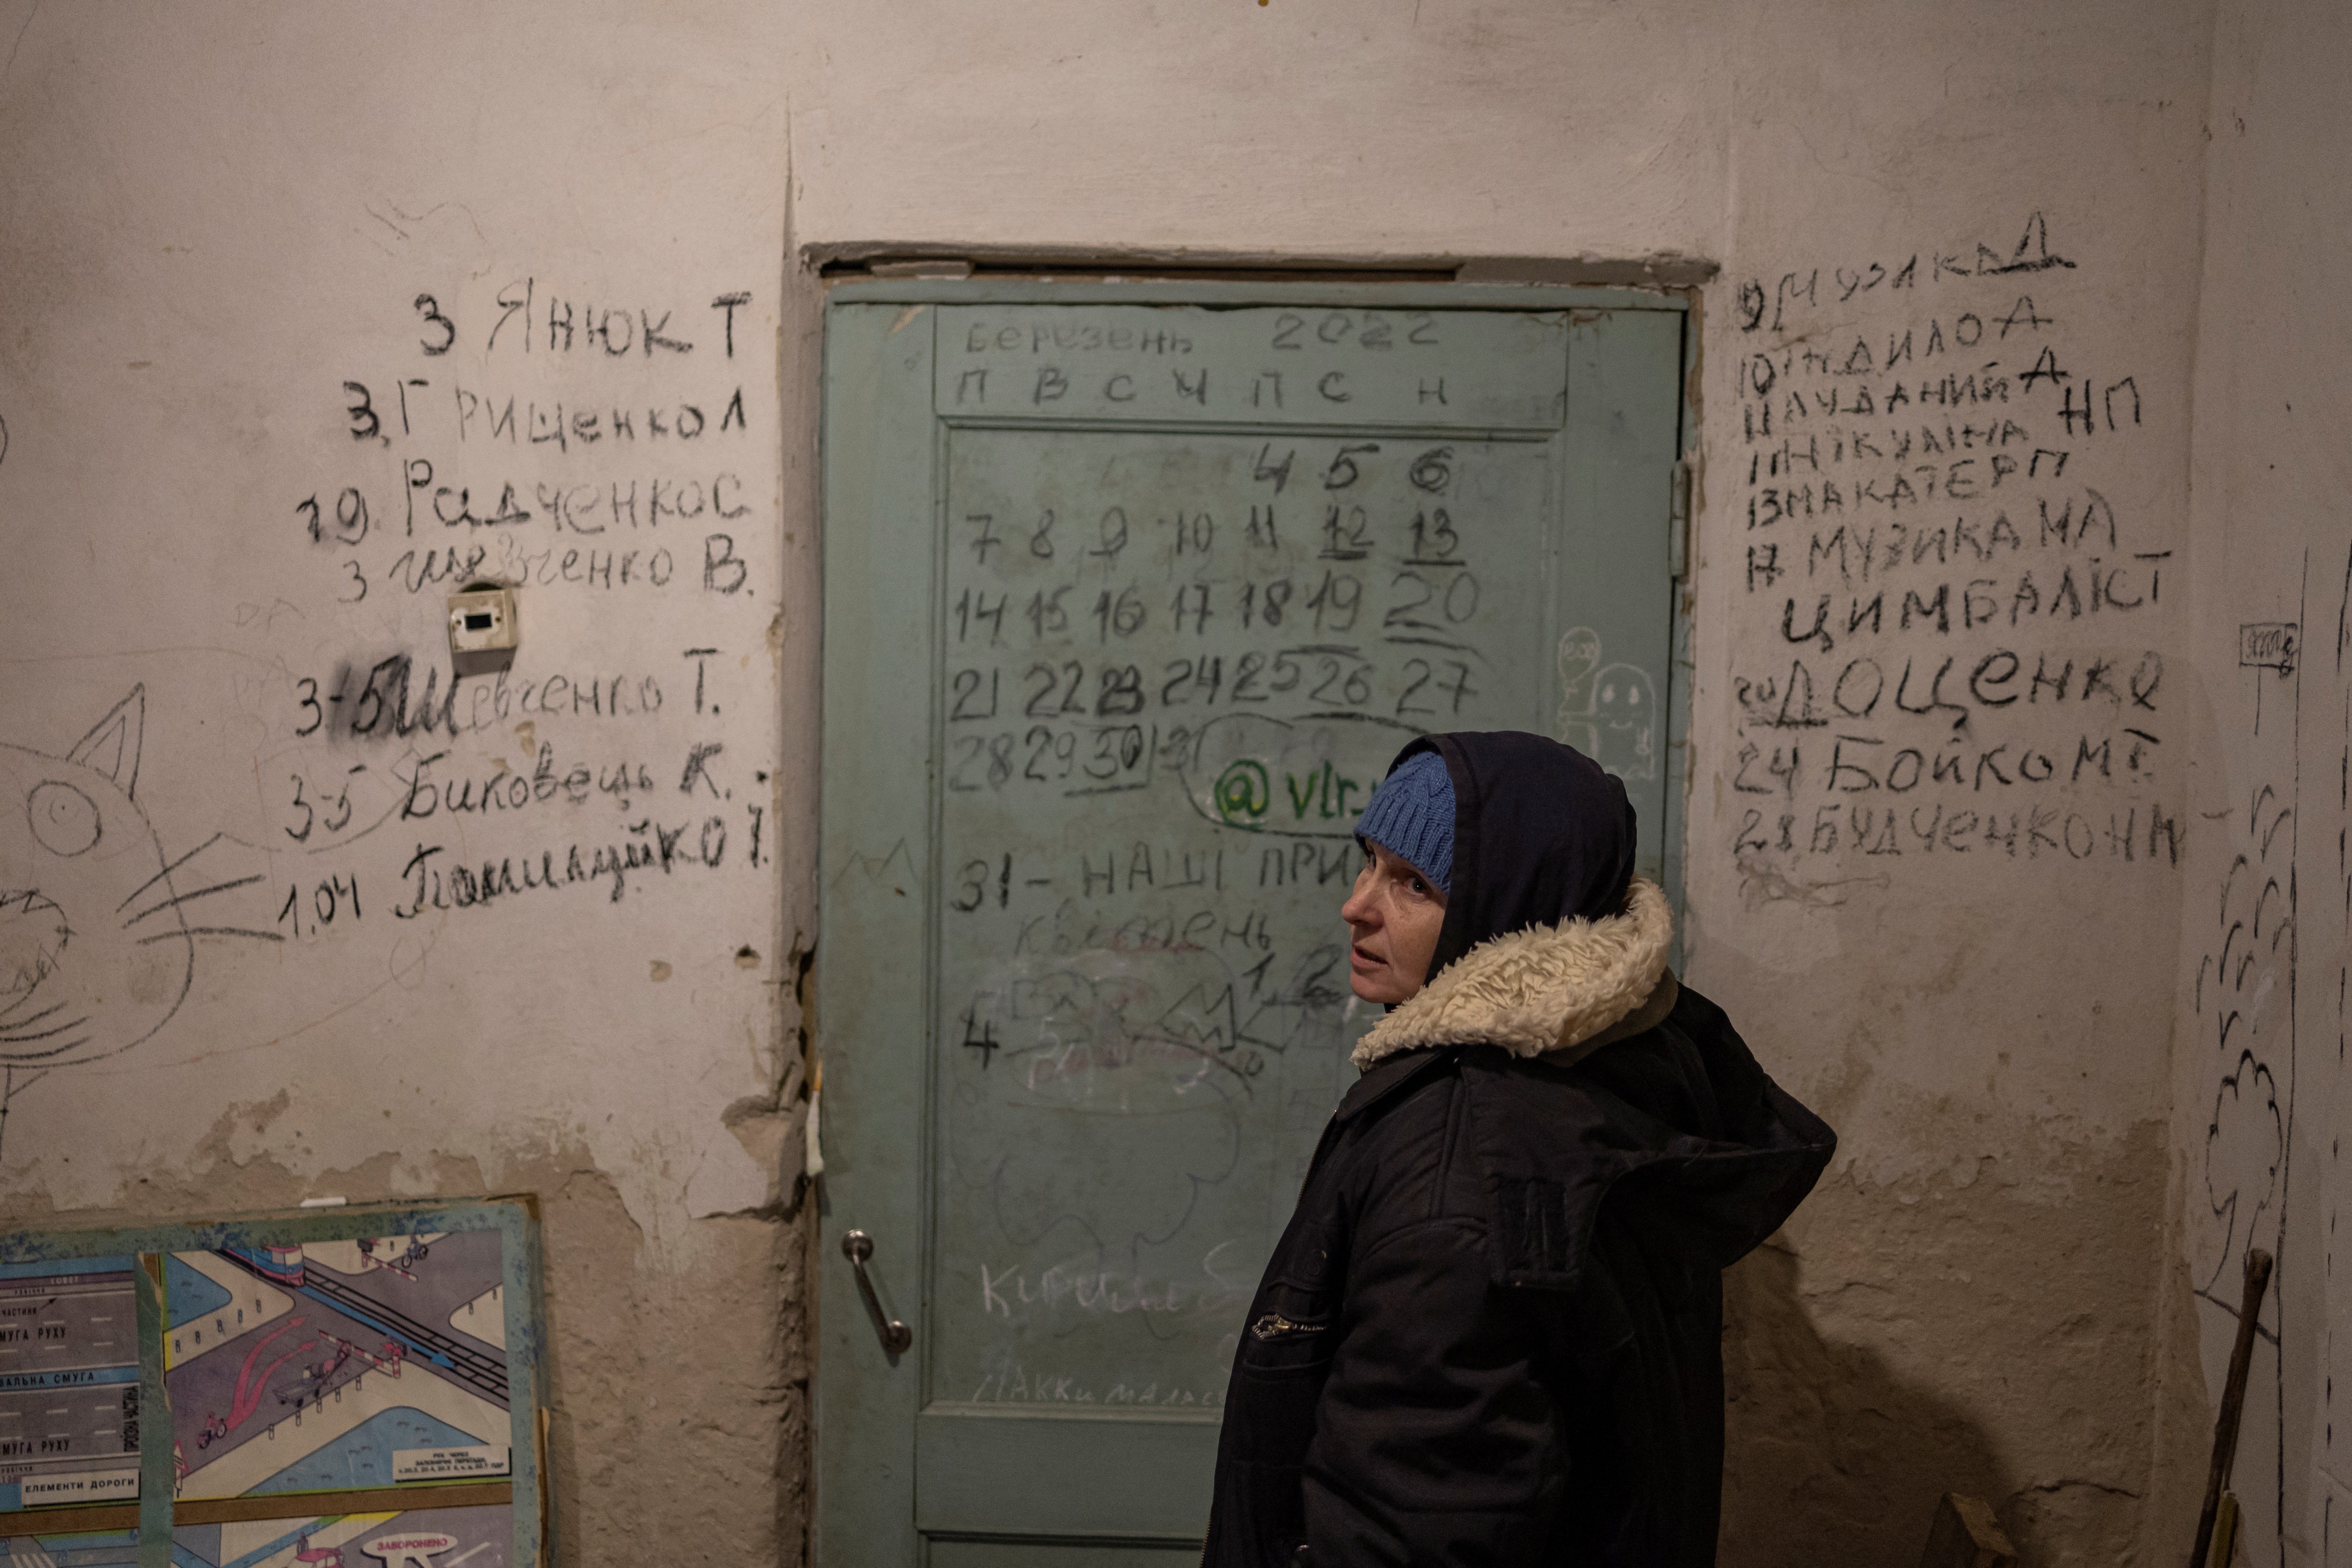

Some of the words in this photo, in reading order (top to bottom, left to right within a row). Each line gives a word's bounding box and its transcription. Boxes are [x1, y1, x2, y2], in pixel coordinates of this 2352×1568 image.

[414, 292, 456, 357] 3
[486, 276, 694, 358] ЯНЮК
[710, 291, 753, 358] Т
[1272, 313, 1439, 353] 2022
[955, 368, 989, 405] П
[1034, 366, 1069, 406] В
[1419, 375, 1447, 406] Н
[1254, 442, 1296, 496] 4
[1323, 443, 1380, 490] 5
[1410, 445, 1453, 494] 6
[965, 513, 1002, 565] 7
[1029, 508, 1056, 559] 8
[1088, 505, 1128, 557] 9
[1174, 510, 1214, 556] 10
[1244, 504, 1279, 550] 11
[1322, 504, 1374, 552] 12
[1411, 508, 1458, 559] 13
[954, 587, 1007, 643] 14
[1024, 584, 1075, 635] 15
[1092, 582, 1147, 641] 16
[1171, 583, 1214, 642] 17
[1240, 579, 1293, 629] 18
[1306, 570, 1363, 639] 19
[1383, 571, 1480, 630] 20
[949, 667, 999, 722] 21
[1024, 660, 1087, 718] 22
[1095, 664, 1145, 718] 23
[1161, 653, 1222, 707] 24
[1231, 650, 1303, 703] 25
[1308, 654, 1375, 706] 26
[1395, 657, 1480, 716] 27
[947, 733, 1016, 792] 28
[1024, 724, 1077, 781] 29
[1082, 724, 1144, 780] 30
[960, 1004, 1000, 1071] 4
[38, 1326, 66, 1339] РУХУ
[53, 1372, 94, 1384] СМУГА
[41, 1439, 70, 1452] РУХУ
[25, 1481, 83, 1493] ЕЛЕМЕНТИ
[90, 1477, 135, 1490] ДОРОГИ
[377, 1538, 448, 1551] ЗАБОРОНЕНО
